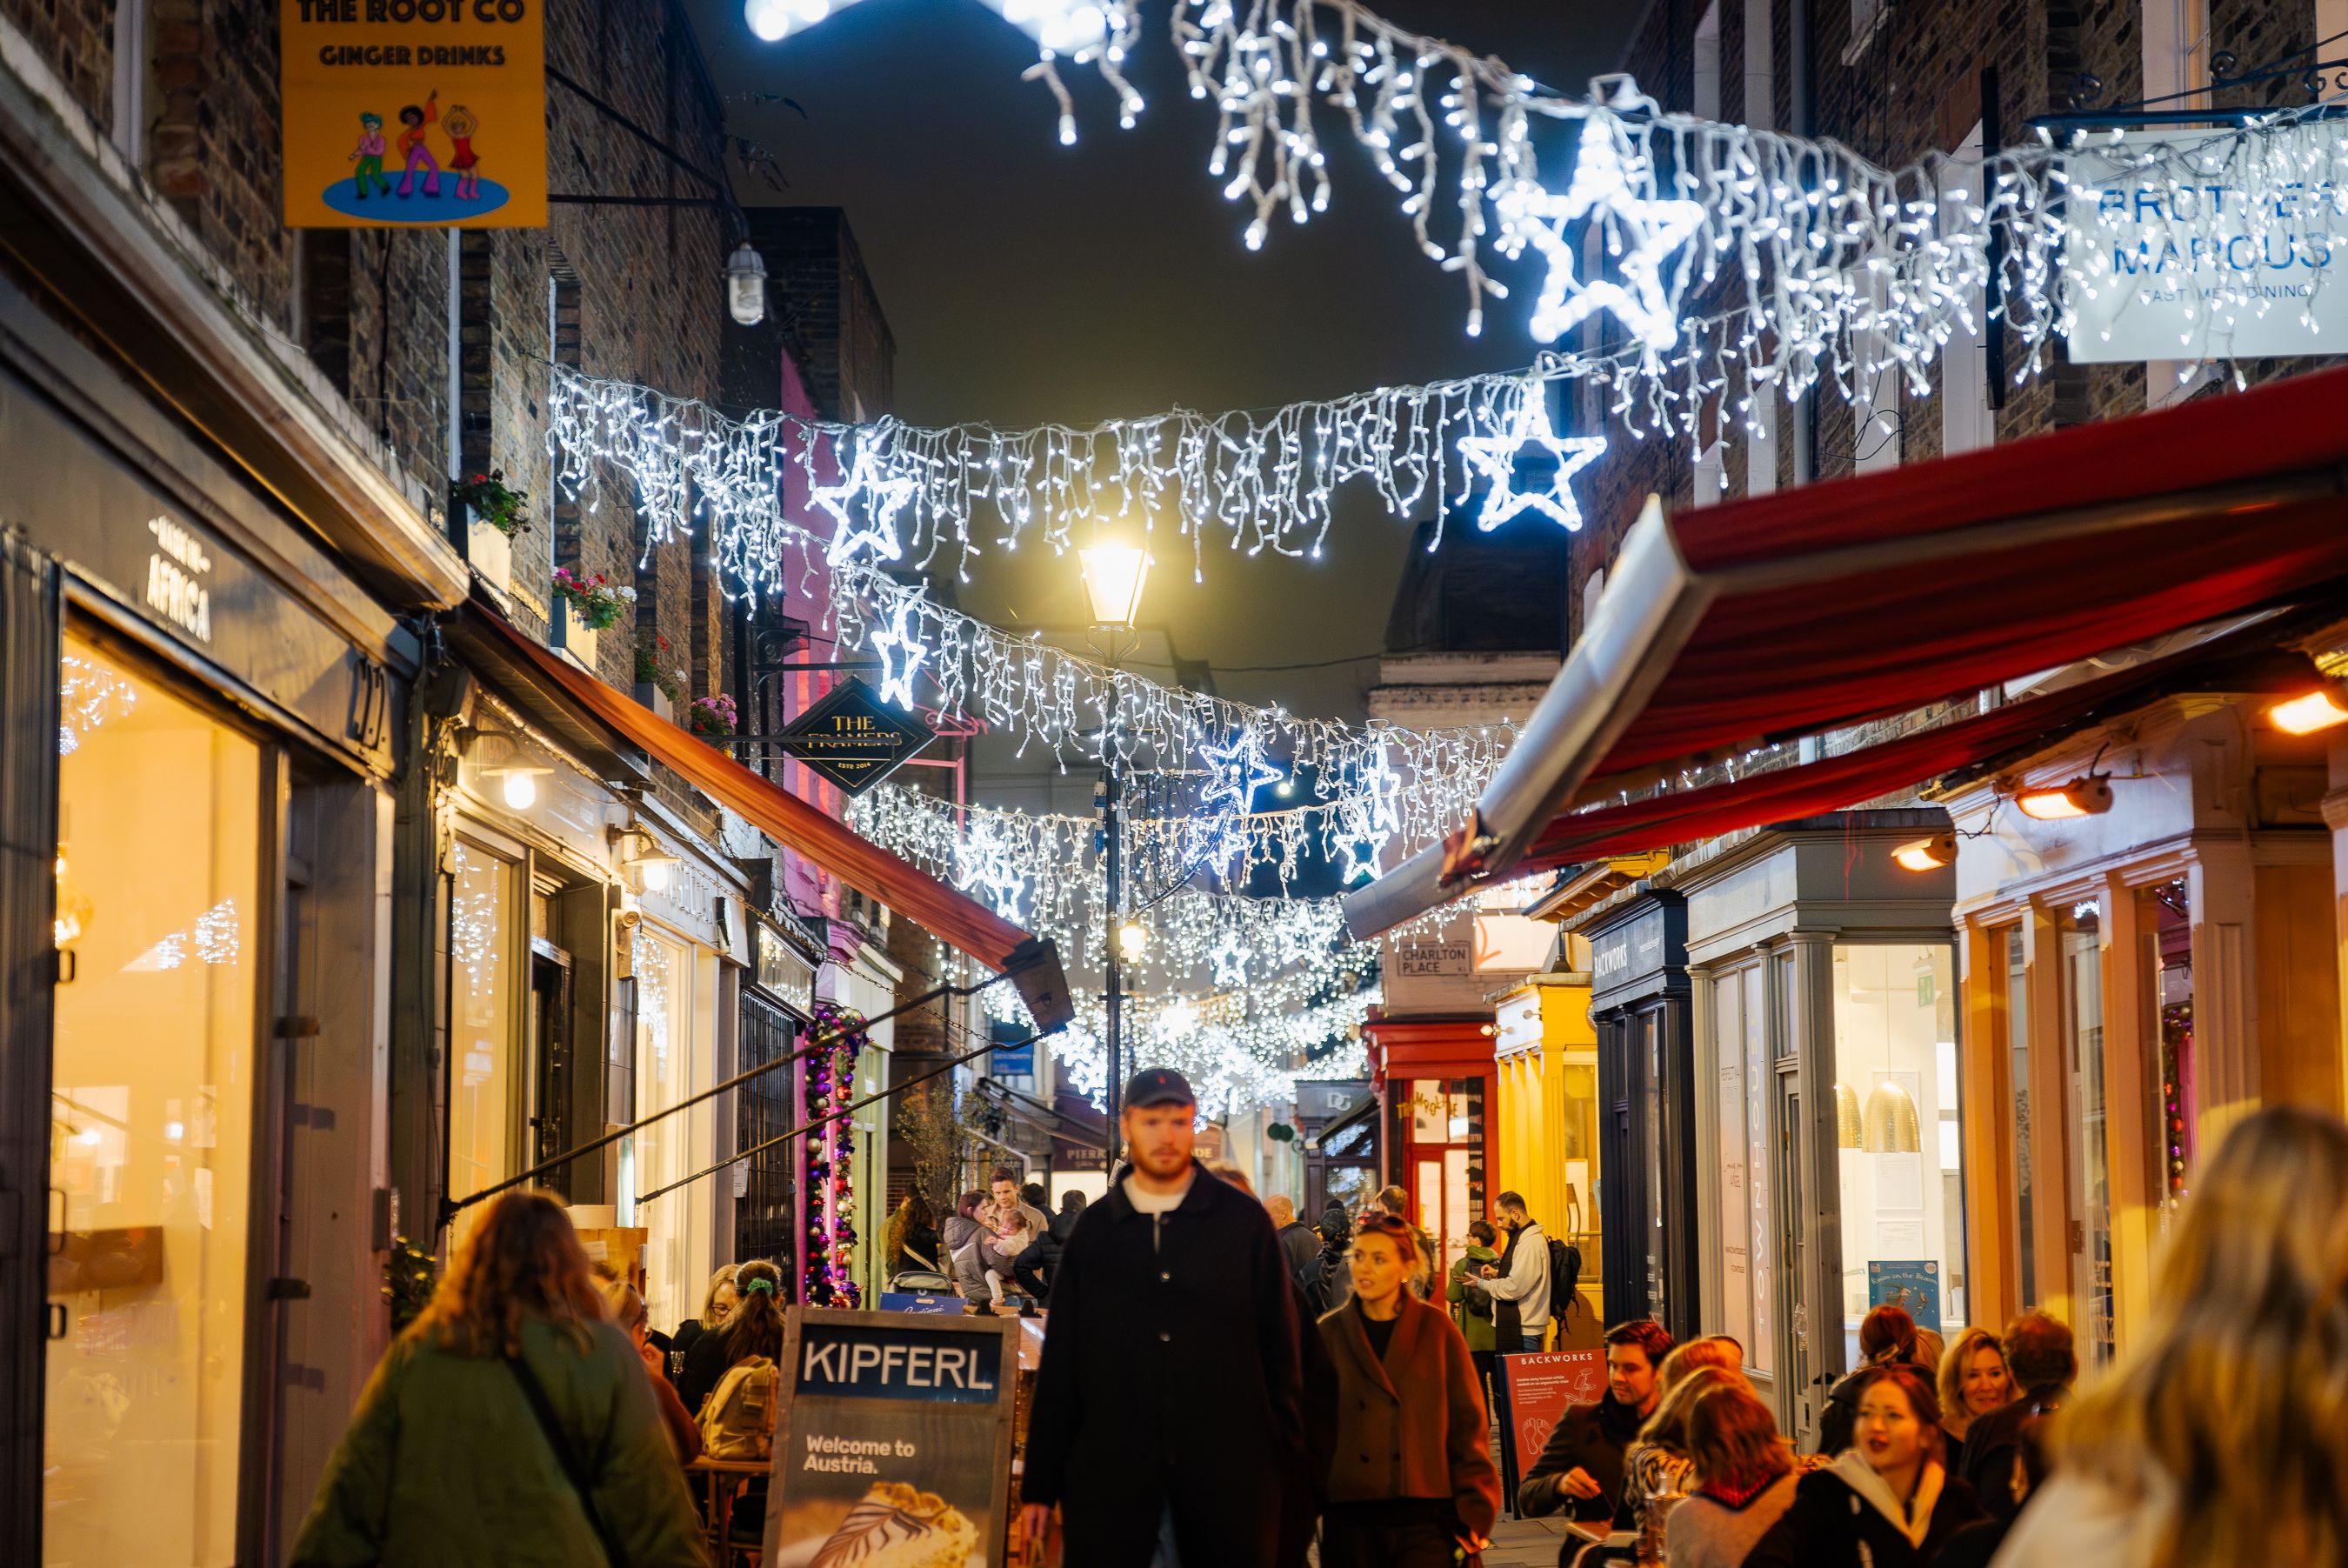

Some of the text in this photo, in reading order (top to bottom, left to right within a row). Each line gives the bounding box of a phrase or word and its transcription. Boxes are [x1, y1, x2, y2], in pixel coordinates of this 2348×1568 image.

[297, 0, 525, 23] THE ROOT CO
[318, 45, 505, 66] GINGER DRINKS
[831, 716, 877, 731] THE
[1403, 949, 1465, 960] CHARLTON
[1403, 962, 1440, 973] PLACE
[803, 1341, 994, 1390] KIPFERL
[1521, 1352, 1593, 1365] BACKWORKS
[805, 1434, 916, 1458] Welcome to
[803, 1454, 878, 1474] Austria.
